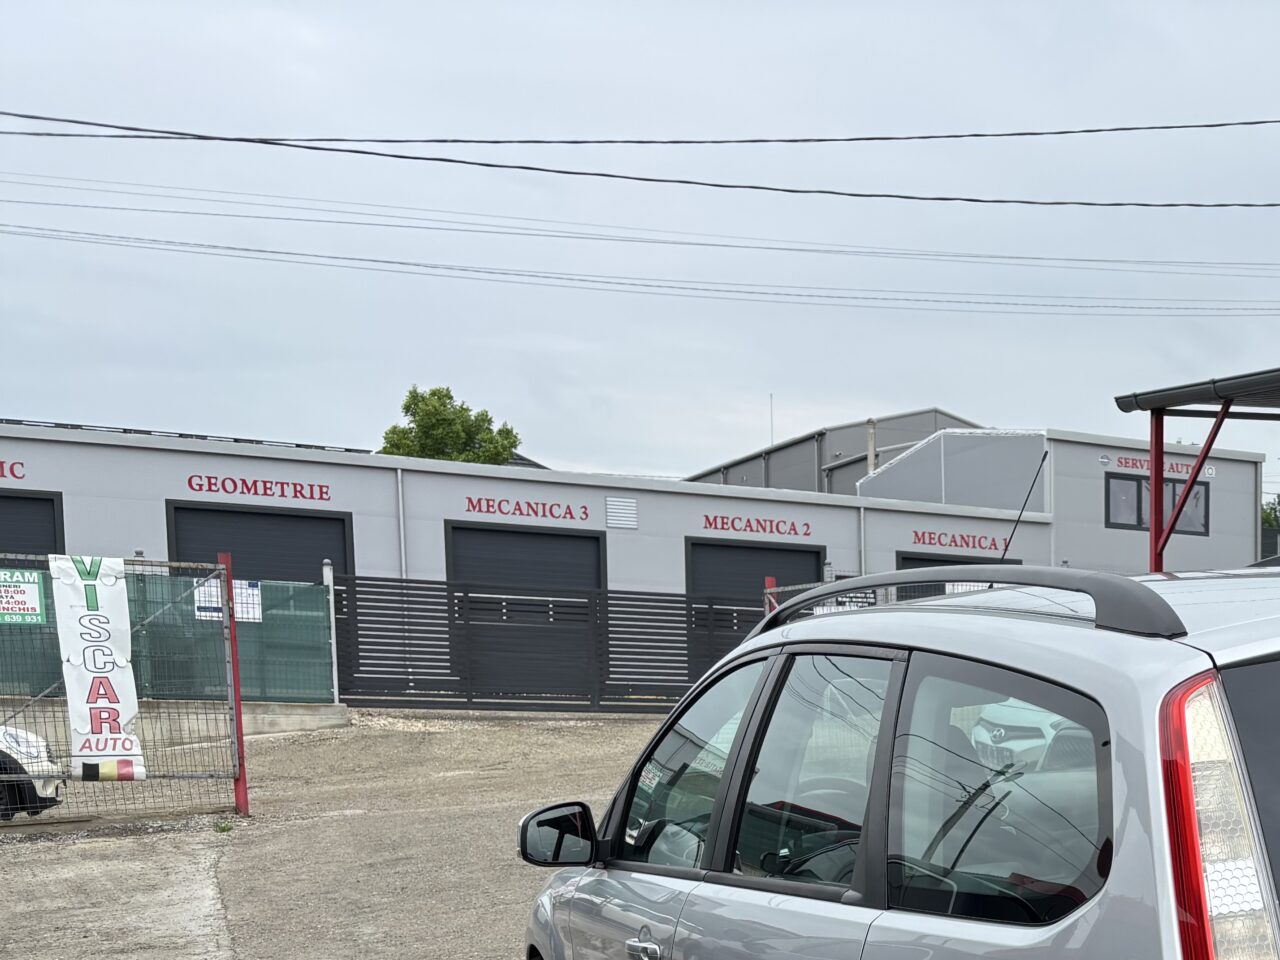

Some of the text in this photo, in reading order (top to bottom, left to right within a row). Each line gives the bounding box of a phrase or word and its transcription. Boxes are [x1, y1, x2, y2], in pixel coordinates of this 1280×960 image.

[1117, 456, 1196, 475] SERVI AUT
[187, 474, 332, 501] GEOMETRIE
[465, 496, 590, 521] MECANICA 3
[703, 514, 812, 537] MECANICA 2
[912, 530, 1010, 552] MECANICA 1
[0, 571, 38, 582] RAM
[70, 556, 121, 735] VISCAR
[78, 737, 134, 752] AUTO
